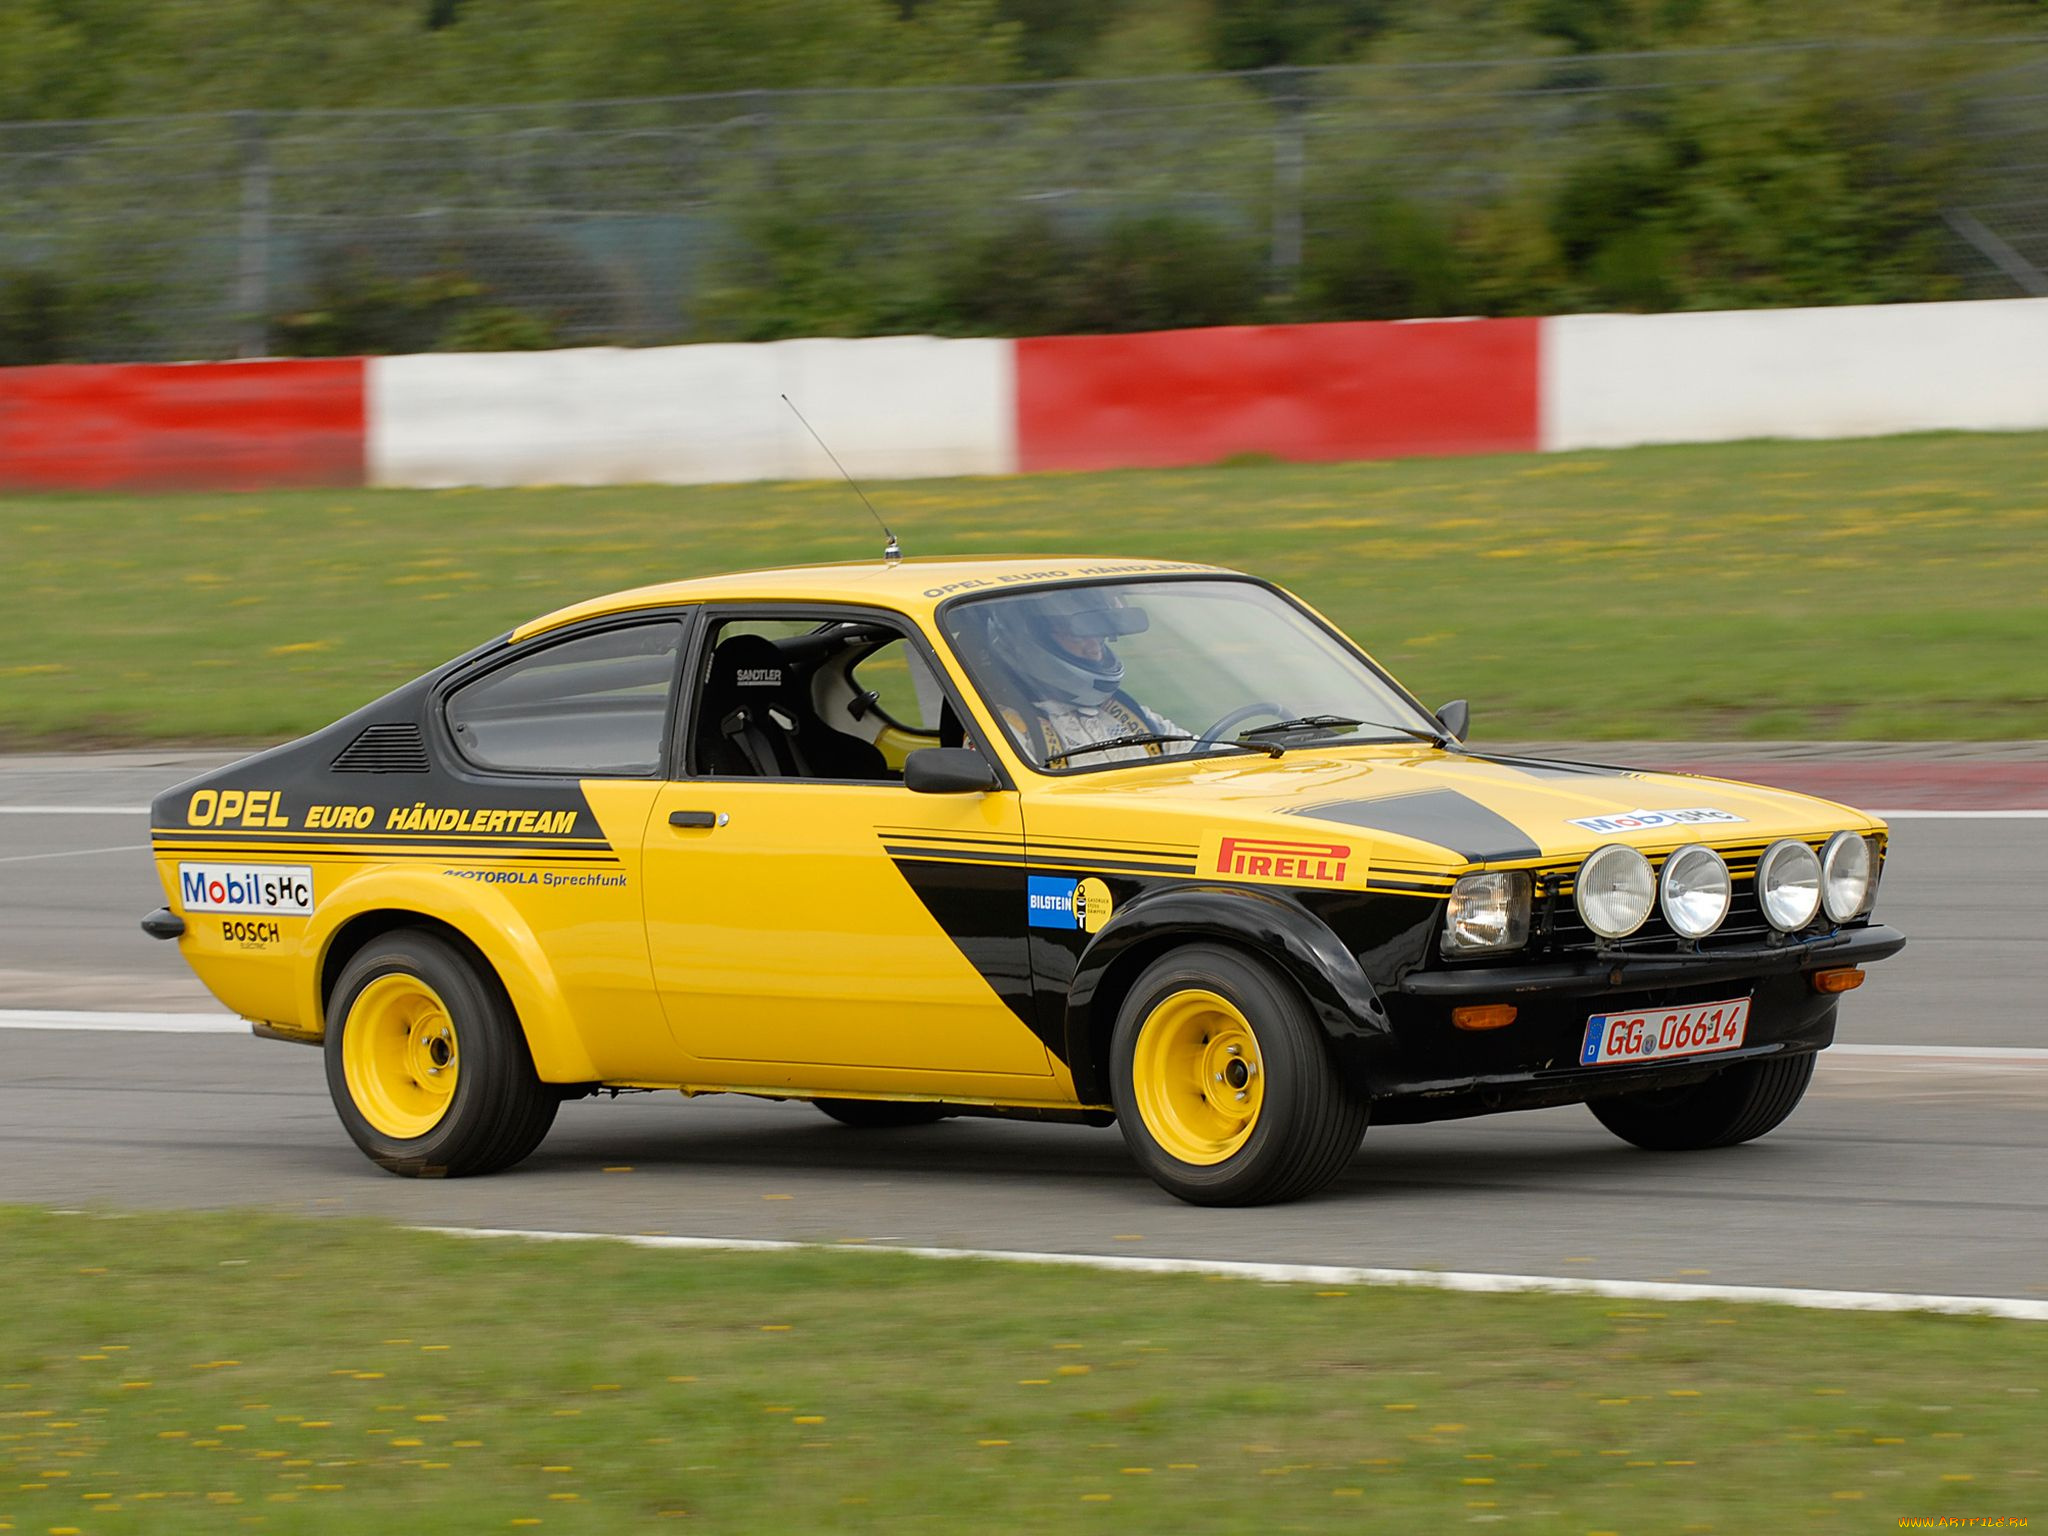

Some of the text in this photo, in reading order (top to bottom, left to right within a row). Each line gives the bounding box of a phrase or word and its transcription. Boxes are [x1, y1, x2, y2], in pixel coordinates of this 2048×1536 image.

[923, 580, 994, 598] OPEL
[998, 571, 1069, 582] EURO
[736, 669, 782, 681] SANDTLER
[187, 789, 578, 834] OPEL EURO HÄNDLERTEAM
[1216, 837, 1351, 882] PIRELLI
[183, 871, 261, 905] Mobil
[543, 873, 627, 888] Sprechfunk
[1030, 894, 1072, 911] BILSTEIN
[222, 921, 280, 943] BOSCH
[1588, 1044, 1596, 1056] D
[1606, 1019, 1645, 1056] GG
[1658, 1007, 1740, 1050] 06614
